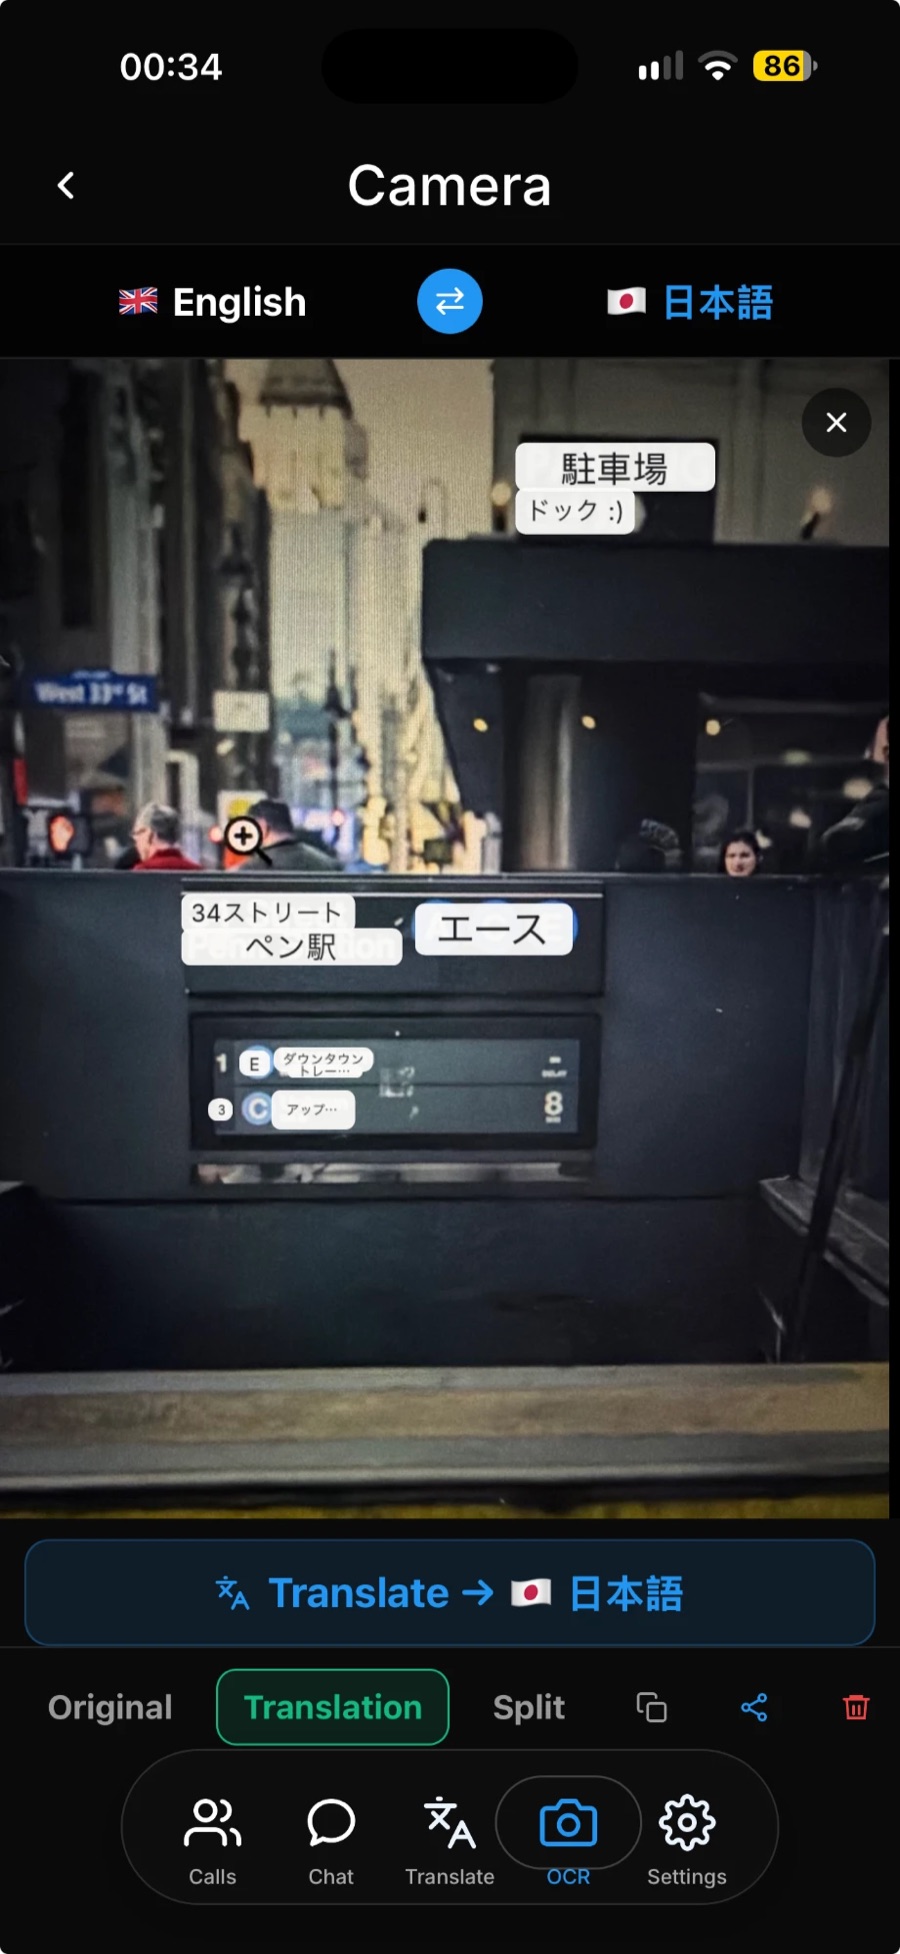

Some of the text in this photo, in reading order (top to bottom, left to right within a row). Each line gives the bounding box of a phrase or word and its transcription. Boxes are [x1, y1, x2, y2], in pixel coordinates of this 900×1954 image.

[120, 53, 223, 82] 00:34
[763, 55, 802, 77] 86
[348, 163, 551, 207] Camera
[173, 285, 306, 323] English
[664, 283, 774, 321] 日本語
[35, 682, 85, 704] West
[126, 682, 148, 705] St
[215, 1053, 228, 1074] 1
[248, 1097, 268, 1119] C
[544, 1091, 564, 1116] 8
[269, 1574, 684, 1613] Translate 日本語
[48, 1692, 173, 1727] Original
[243, 1692, 423, 1722] Translation
[493, 1692, 566, 1726] Split
[188, 1868, 237, 1886] Calls
[308, 1868, 354, 1886] Chat
[405, 1868, 495, 1886] Translate
[546, 1868, 591, 1886] OCR
[647, 1868, 728, 1891] Settings
